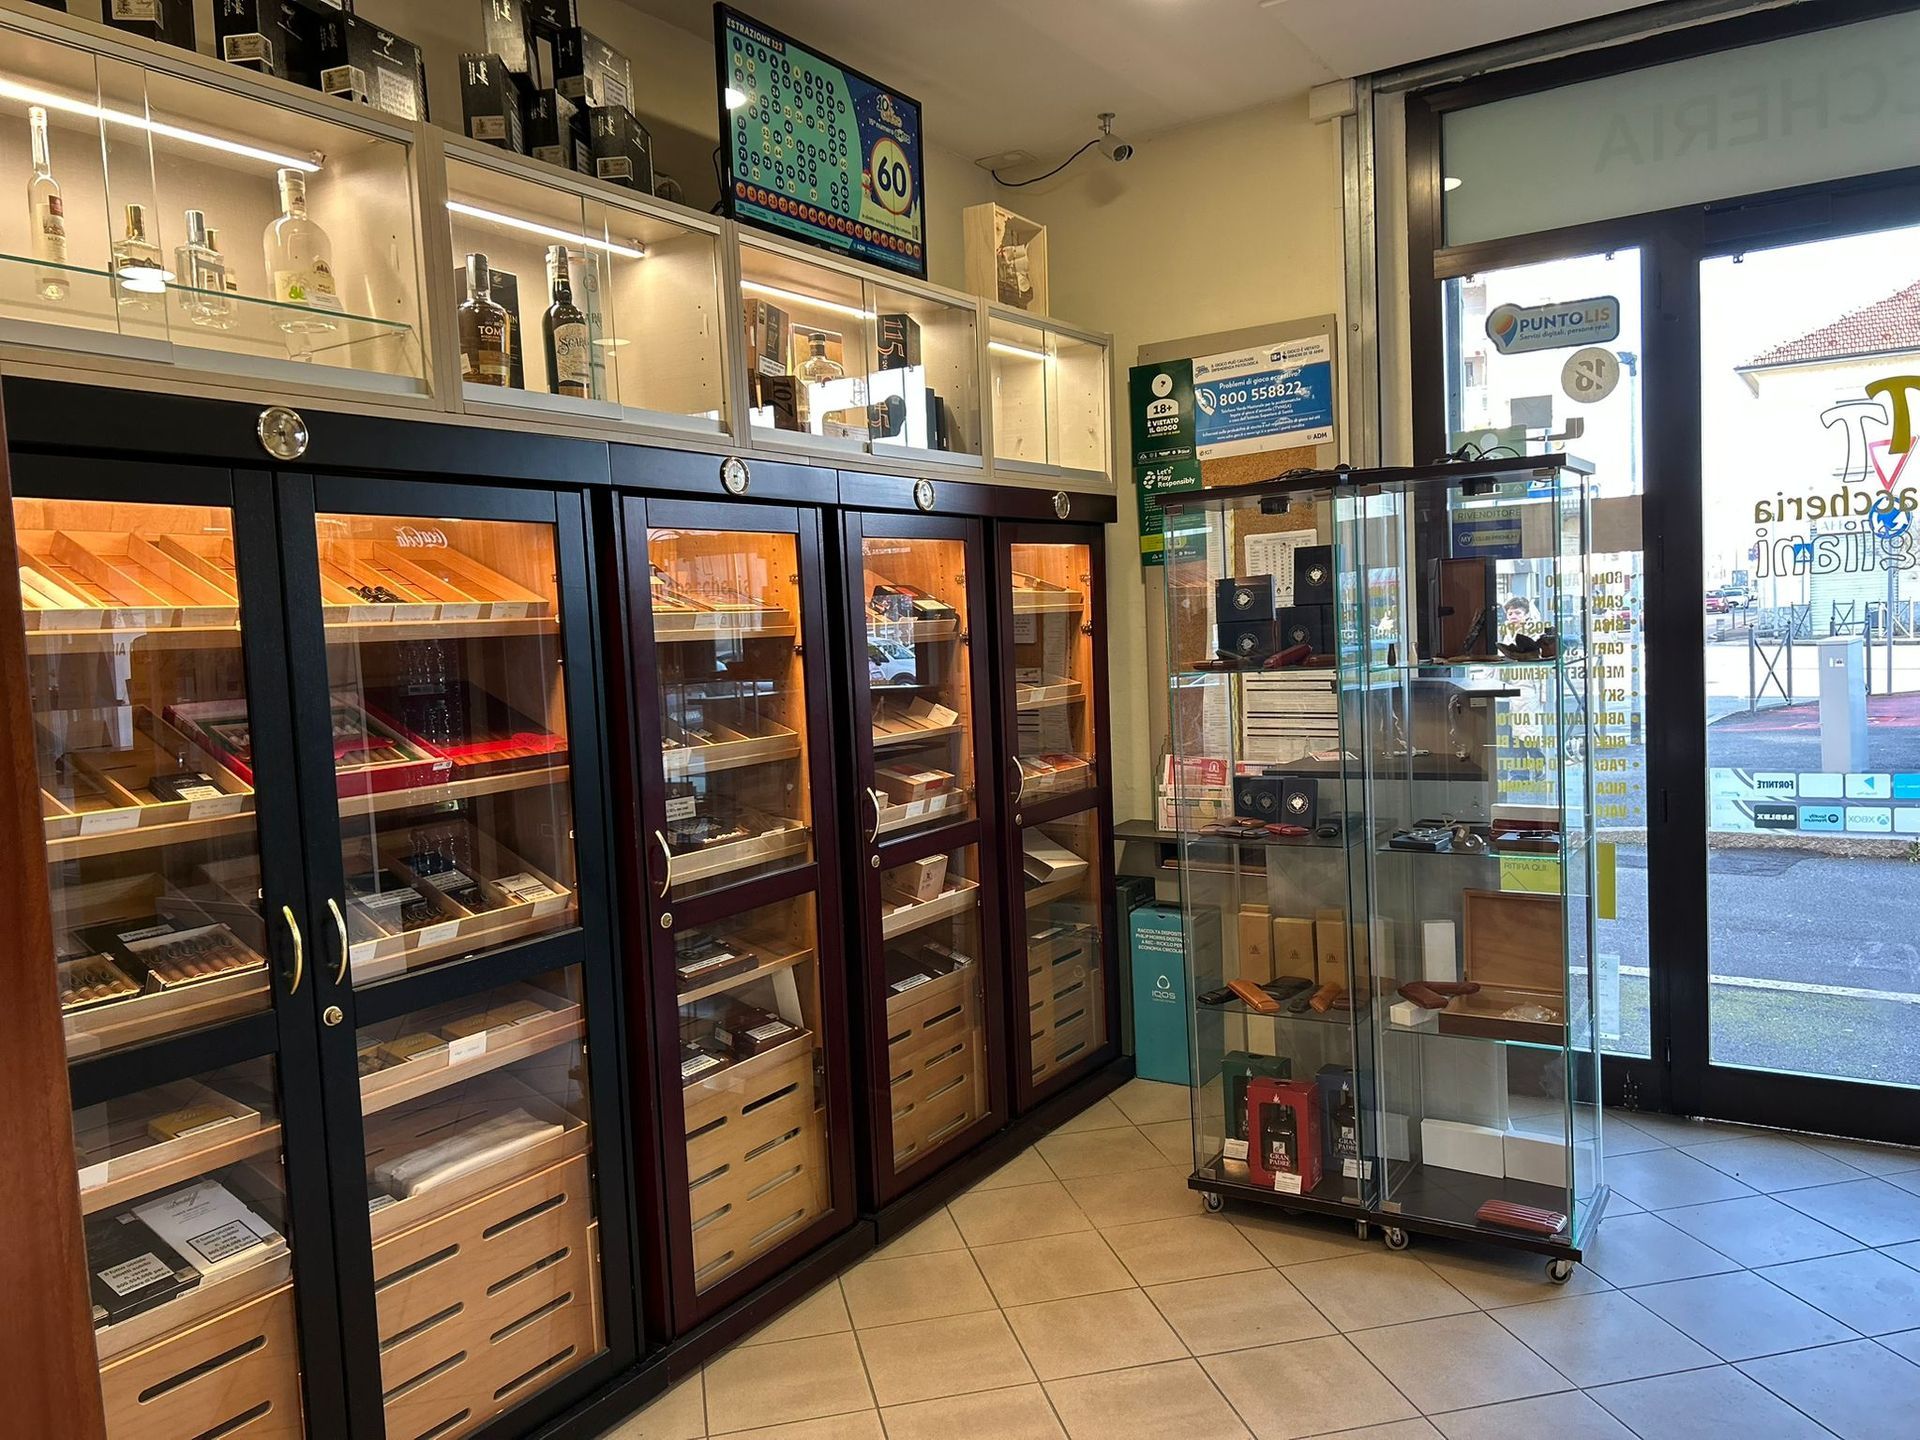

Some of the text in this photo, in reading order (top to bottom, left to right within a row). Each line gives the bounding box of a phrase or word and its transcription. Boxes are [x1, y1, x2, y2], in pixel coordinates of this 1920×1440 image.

[727, 18, 770, 46] ESTRAZIONE
[878, 156, 906, 197] 60
[1520, 308, 1610, 332] PUNTOLIS
[1568, 325, 1594, 336] persone
[1219, 380, 1246, 391] Problemi
[1246, 378, 1253, 386] di
[1253, 376, 1269, 386] gioco
[773, 380, 795, 418] 107
[1219, 381, 1302, 406] 800 558822
[1153, 404, 1172, 415] 18+
[1152, 417, 1179, 427] VIETATO
[1156, 424, 1178, 433] GIOCO
[1313, 432, 1328, 440] ADM
[1157, 474, 1171, 482] Play
[1157, 477, 1196, 489] Responsibly
[1458, 508, 1521, 521] RIVENDITORE
[1503, 861, 1530, 872] RITIRA
[1137, 927, 1160, 935] RACCOLTA
[1151, 989, 1176, 1000] IQOS
[1269, 1152, 1289, 1161] GRAN
[1268, 1159, 1291, 1167] PADRE
